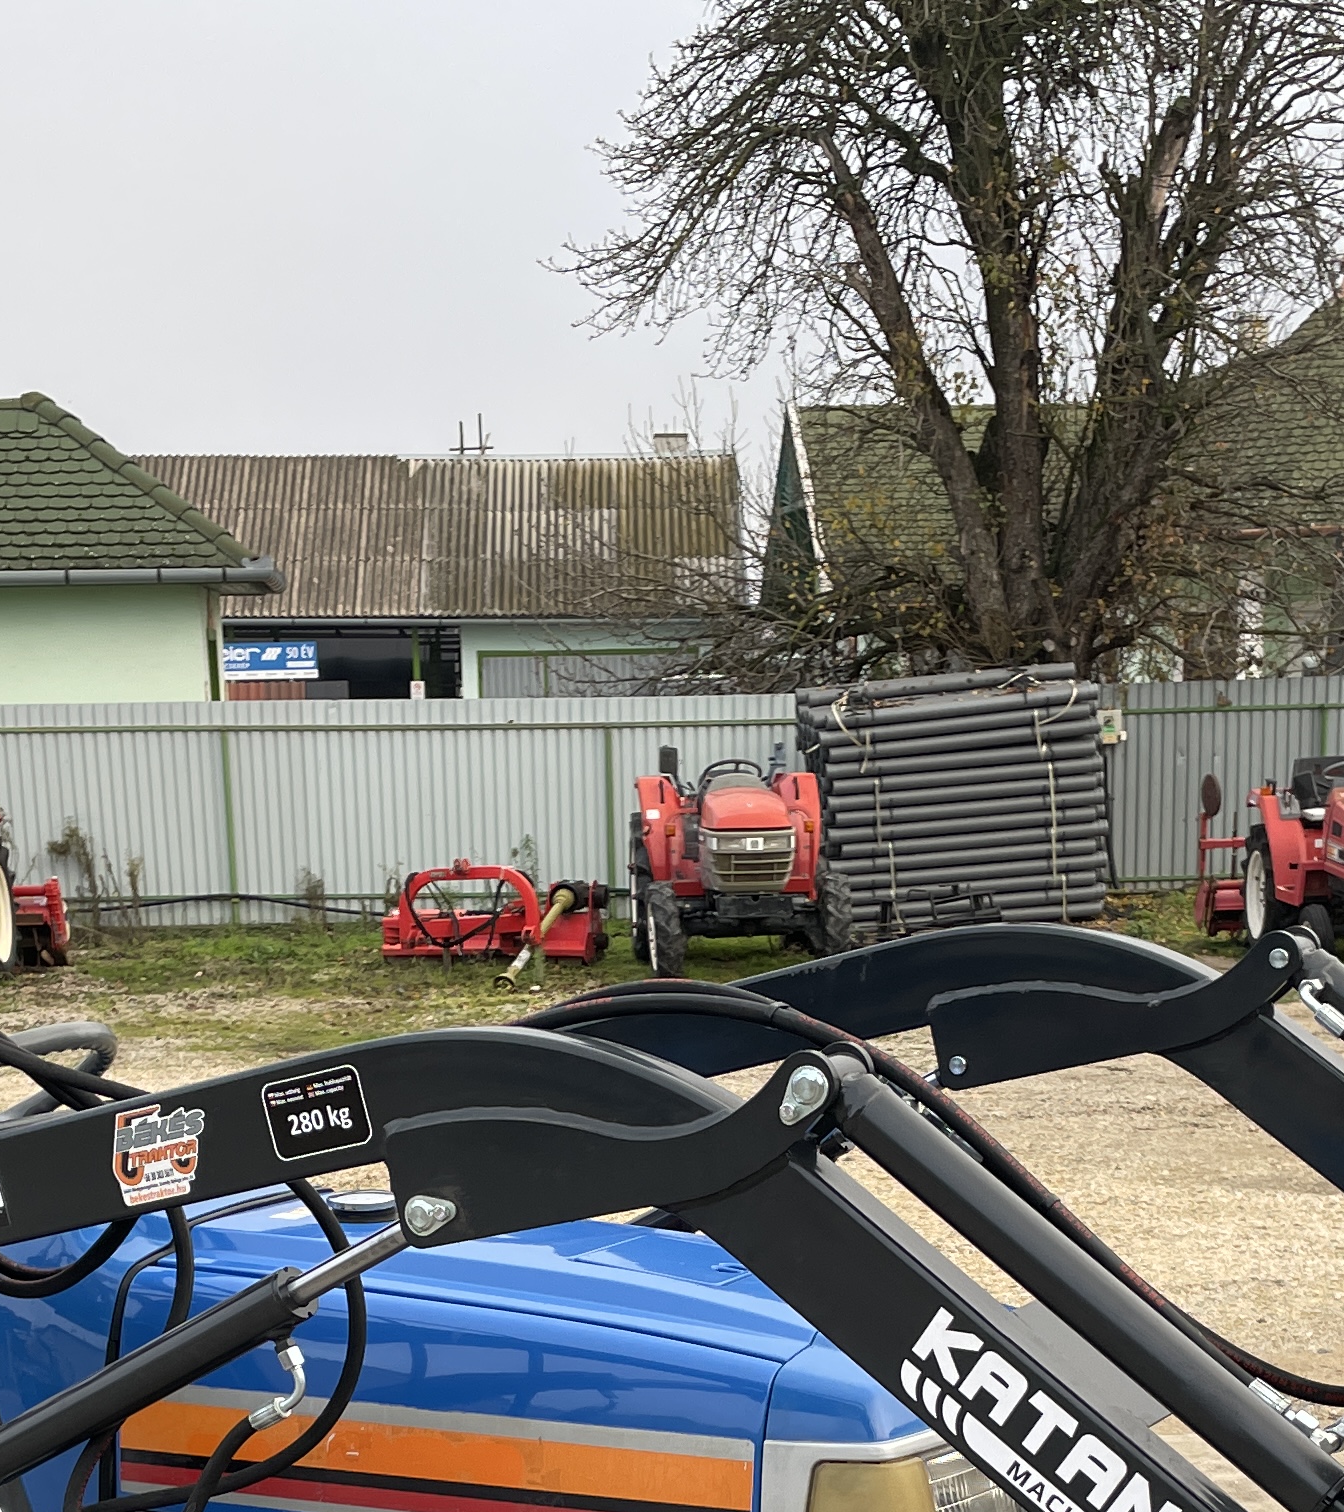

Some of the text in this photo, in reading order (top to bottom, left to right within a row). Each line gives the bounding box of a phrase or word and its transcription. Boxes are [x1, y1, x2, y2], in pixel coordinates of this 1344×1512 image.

[222, 646, 261, 661] eier
[116, 1110, 203, 1153] BÉKÉS
[287, 1104, 353, 1136] 280 kg
[129, 1139, 197, 1168] TRAKTOR
